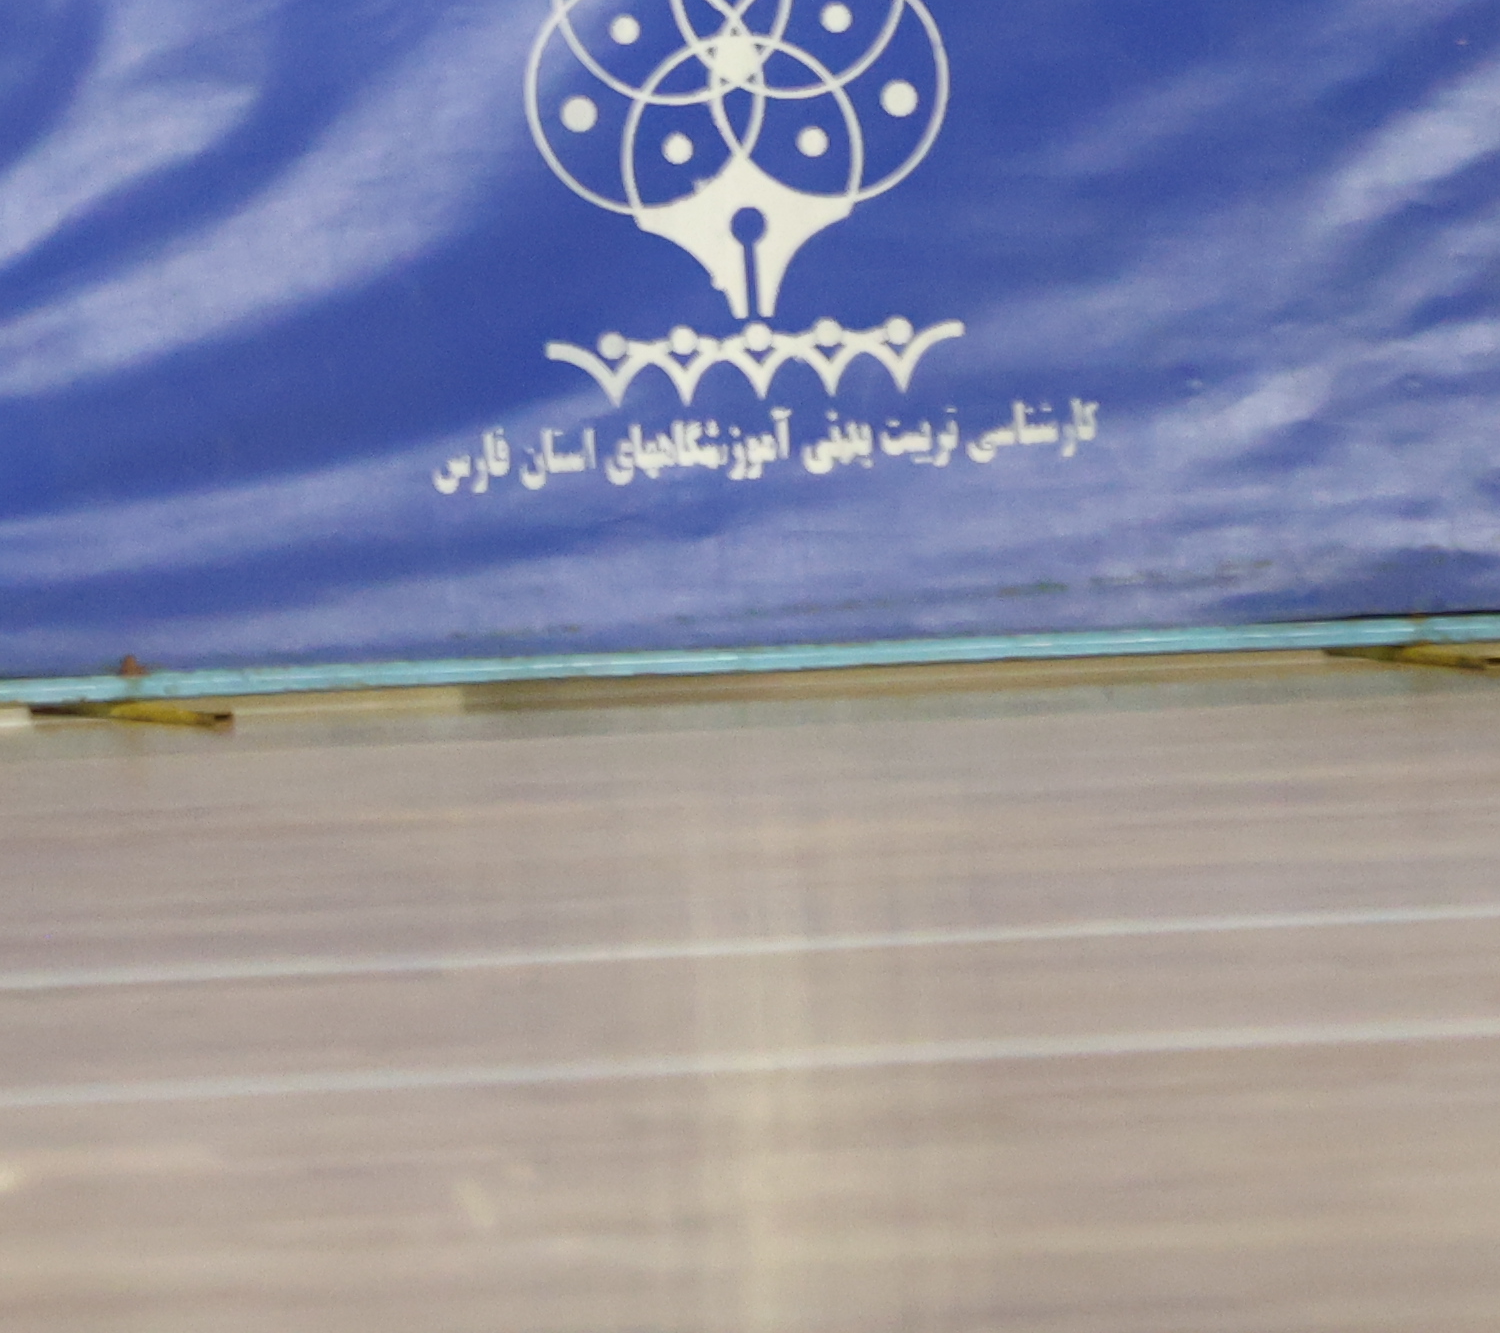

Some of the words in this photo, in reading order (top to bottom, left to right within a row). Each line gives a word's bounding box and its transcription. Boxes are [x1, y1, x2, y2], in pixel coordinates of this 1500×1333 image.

[433, 426, 511, 495] فارس
[519, 427, 597, 491] استان
[803, 408, 873, 475] بدنی
[880, 405, 959, 468] تربیت
[966, 397, 1099, 464] کارشناسی
